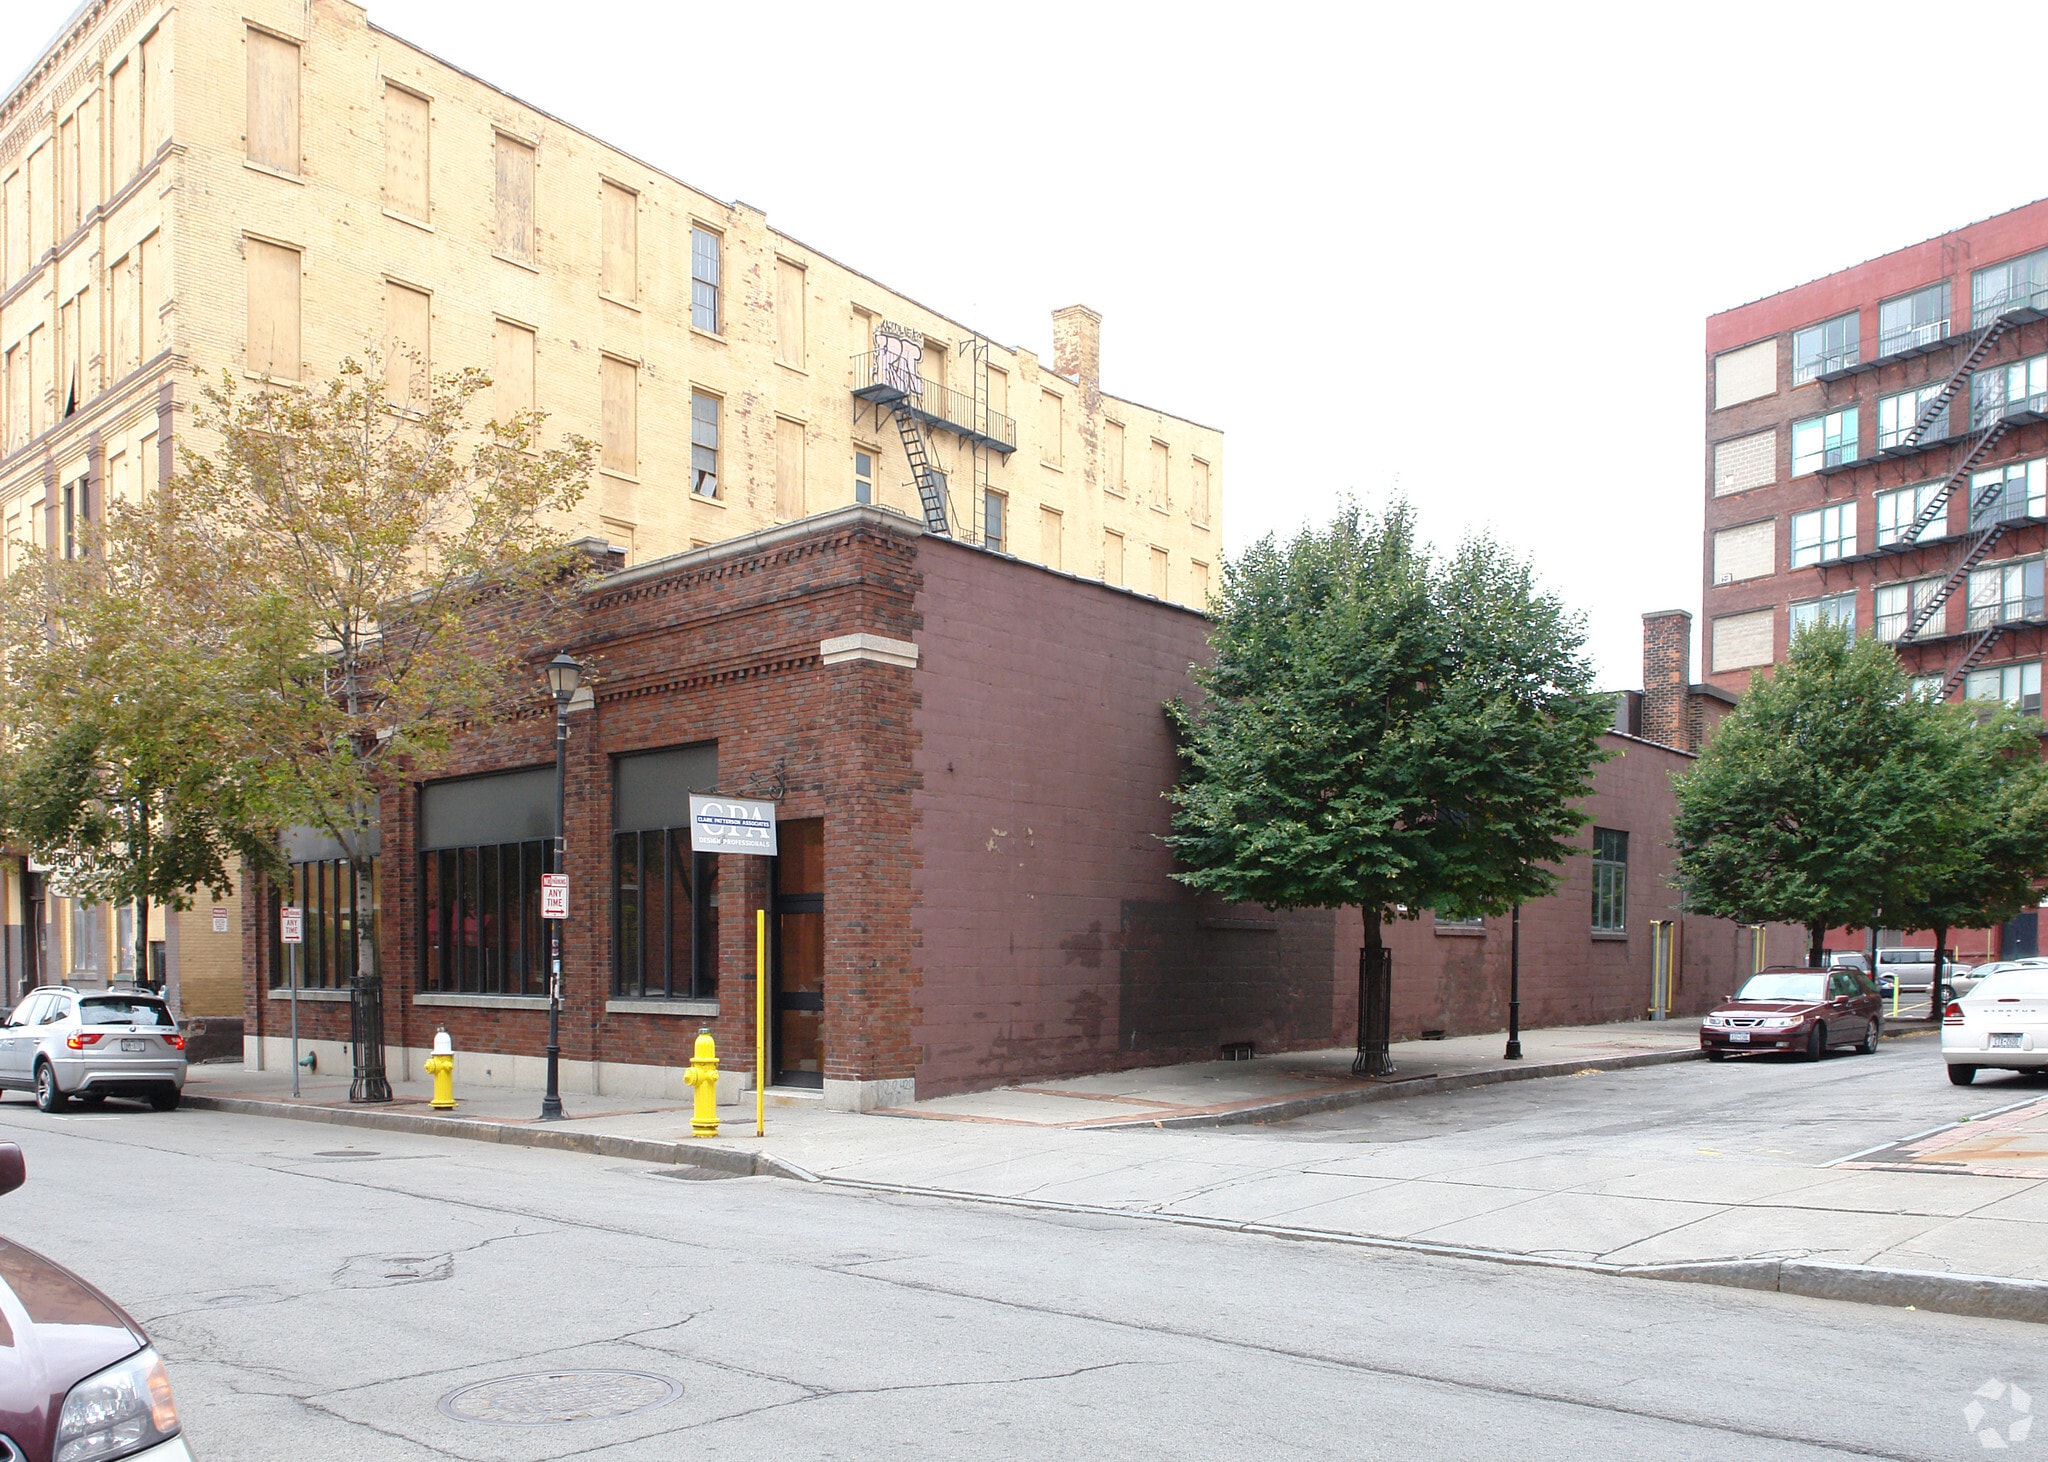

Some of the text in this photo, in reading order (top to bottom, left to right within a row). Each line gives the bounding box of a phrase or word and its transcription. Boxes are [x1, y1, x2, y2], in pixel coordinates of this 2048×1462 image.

[700, 803, 770, 838] CPA
[699, 837, 770, 848] DESIGN PROFESSIONALS
[547, 898, 563, 907] TIME
